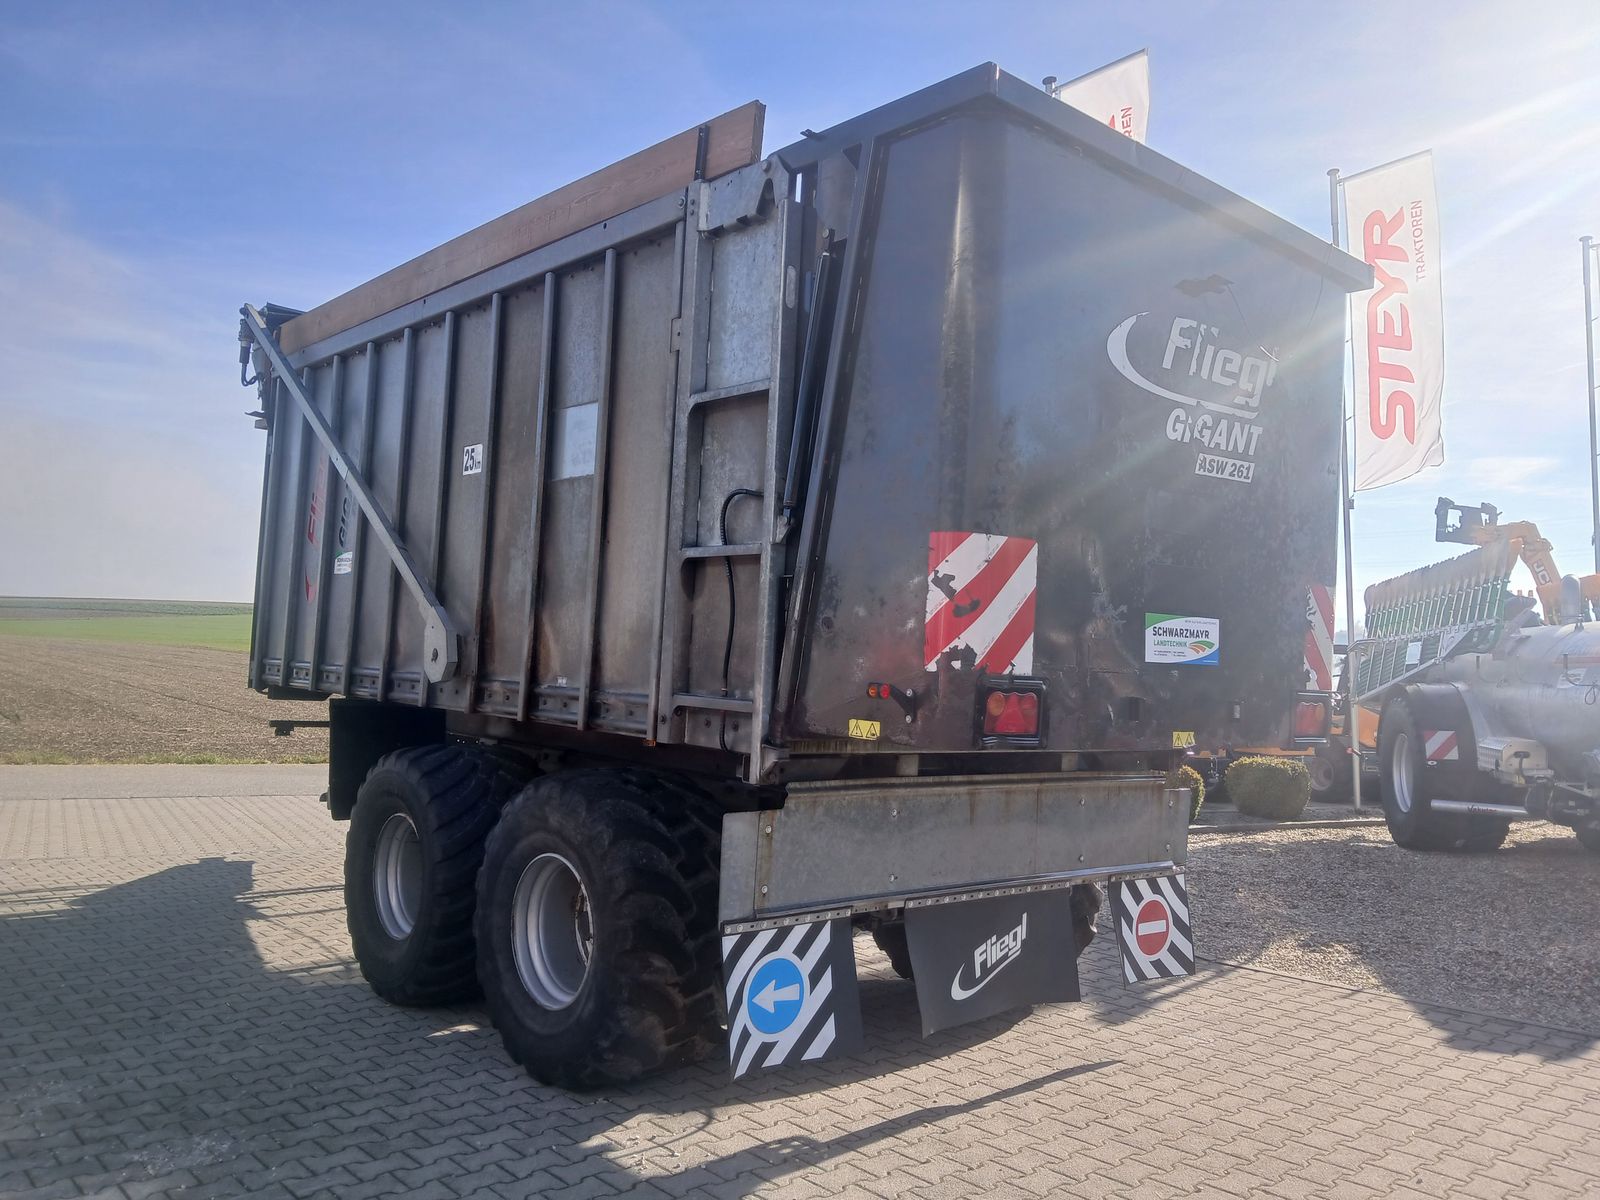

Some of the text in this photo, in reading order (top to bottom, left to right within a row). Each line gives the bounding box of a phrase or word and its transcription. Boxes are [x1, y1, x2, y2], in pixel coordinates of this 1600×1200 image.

[1409, 199, 1427, 283] TRAKTOREN
[1363, 206, 1415, 445] STEYR
[1166, 408, 1263, 456] GIGANT
[464, 447, 475, 472] 25
[1198, 455, 1252, 480] ASW 261
[1152, 626, 1210, 639] SCHWARZMAYR
[1153, 639, 1188, 648] LANDTECHNIK
[974, 912, 1028, 979] Fliegl
